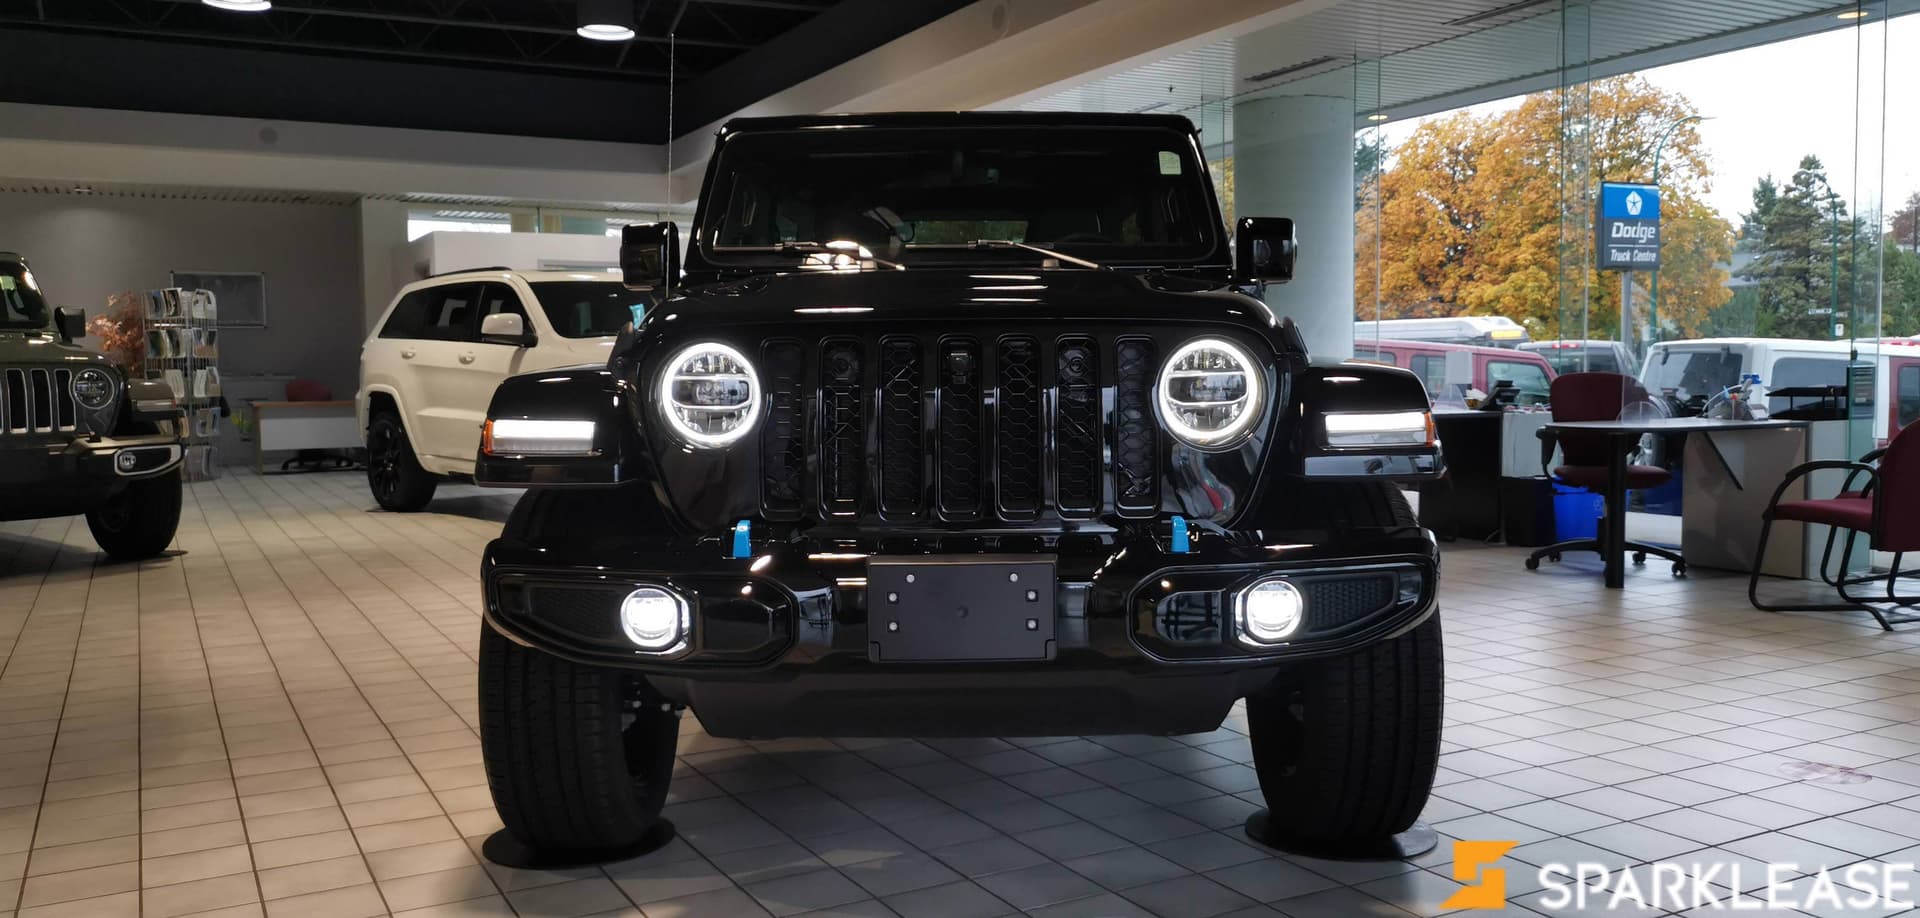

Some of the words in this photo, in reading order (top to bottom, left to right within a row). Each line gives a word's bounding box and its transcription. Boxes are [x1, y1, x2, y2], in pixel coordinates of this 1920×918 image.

[1611, 222, 1656, 243] Dodge
[1610, 249, 1631, 262] Truck
[1632, 249, 1657, 262] Centre
